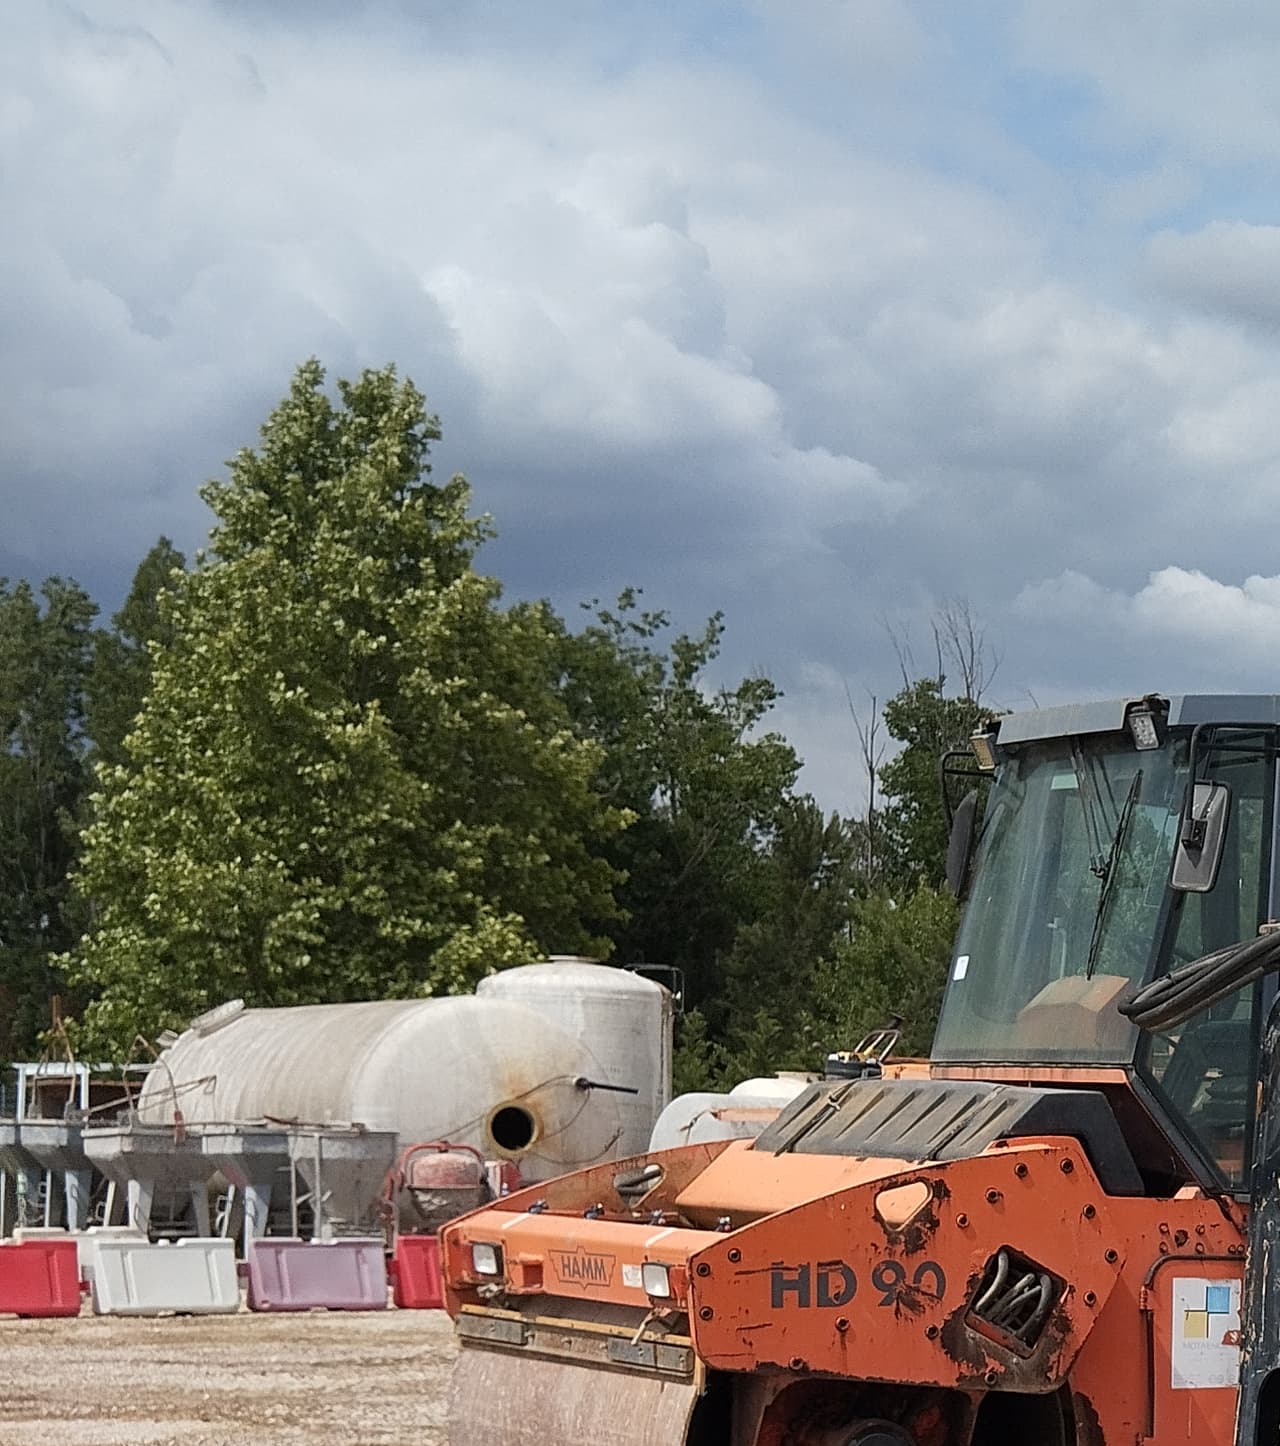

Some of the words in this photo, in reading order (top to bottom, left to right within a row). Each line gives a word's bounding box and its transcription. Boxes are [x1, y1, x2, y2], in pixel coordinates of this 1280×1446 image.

[561, 1255, 608, 1282] HAMM
[771, 1260, 858, 1308] HD
[871, 1259, 947, 1309] 90
